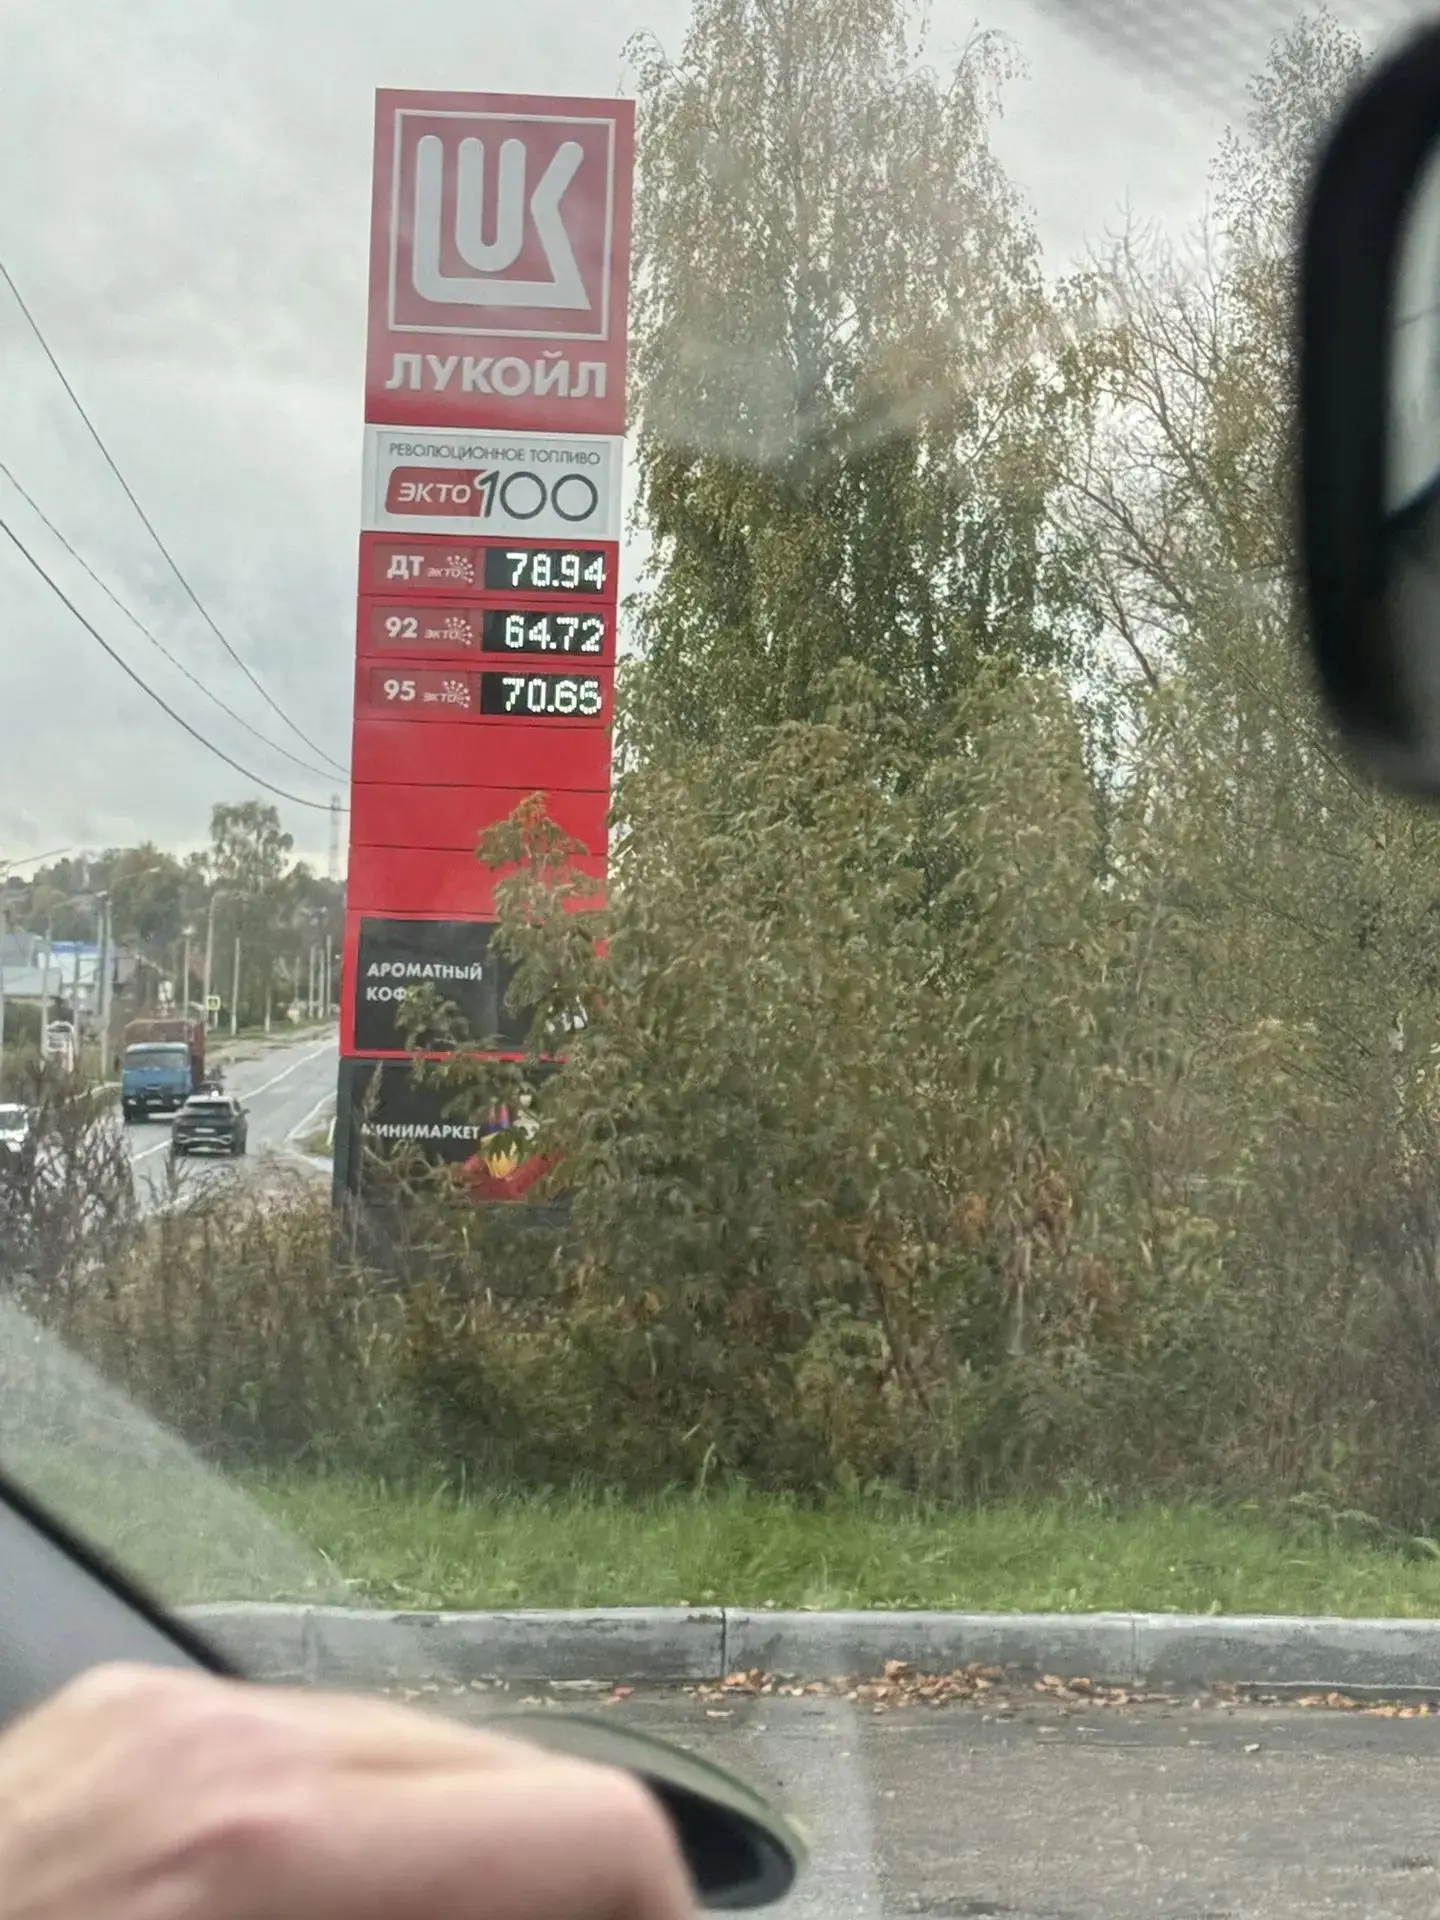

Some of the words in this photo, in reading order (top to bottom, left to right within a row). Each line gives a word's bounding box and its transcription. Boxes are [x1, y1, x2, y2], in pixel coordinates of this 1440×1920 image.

[385, 350, 607, 398] ЛУКОЙЛ
[389, 442, 525, 462] РЕВОЛЮЦИОННОЕ
[530, 448, 601, 465] ТОПЛИВО
[397, 482, 471, 504] ЭКТО
[475, 470, 599, 522] 100
[386, 554, 425, 580] ДТ
[505, 552, 606, 590] 78.94
[384, 616, 419, 639] 92
[504, 614, 605, 652] 64.72
[383, 679, 416, 701] 95
[501, 677, 603, 715] 70.65
[365, 962, 483, 981] АРОМАТНЫЙ
[366, 986, 413, 1002] КОФ
